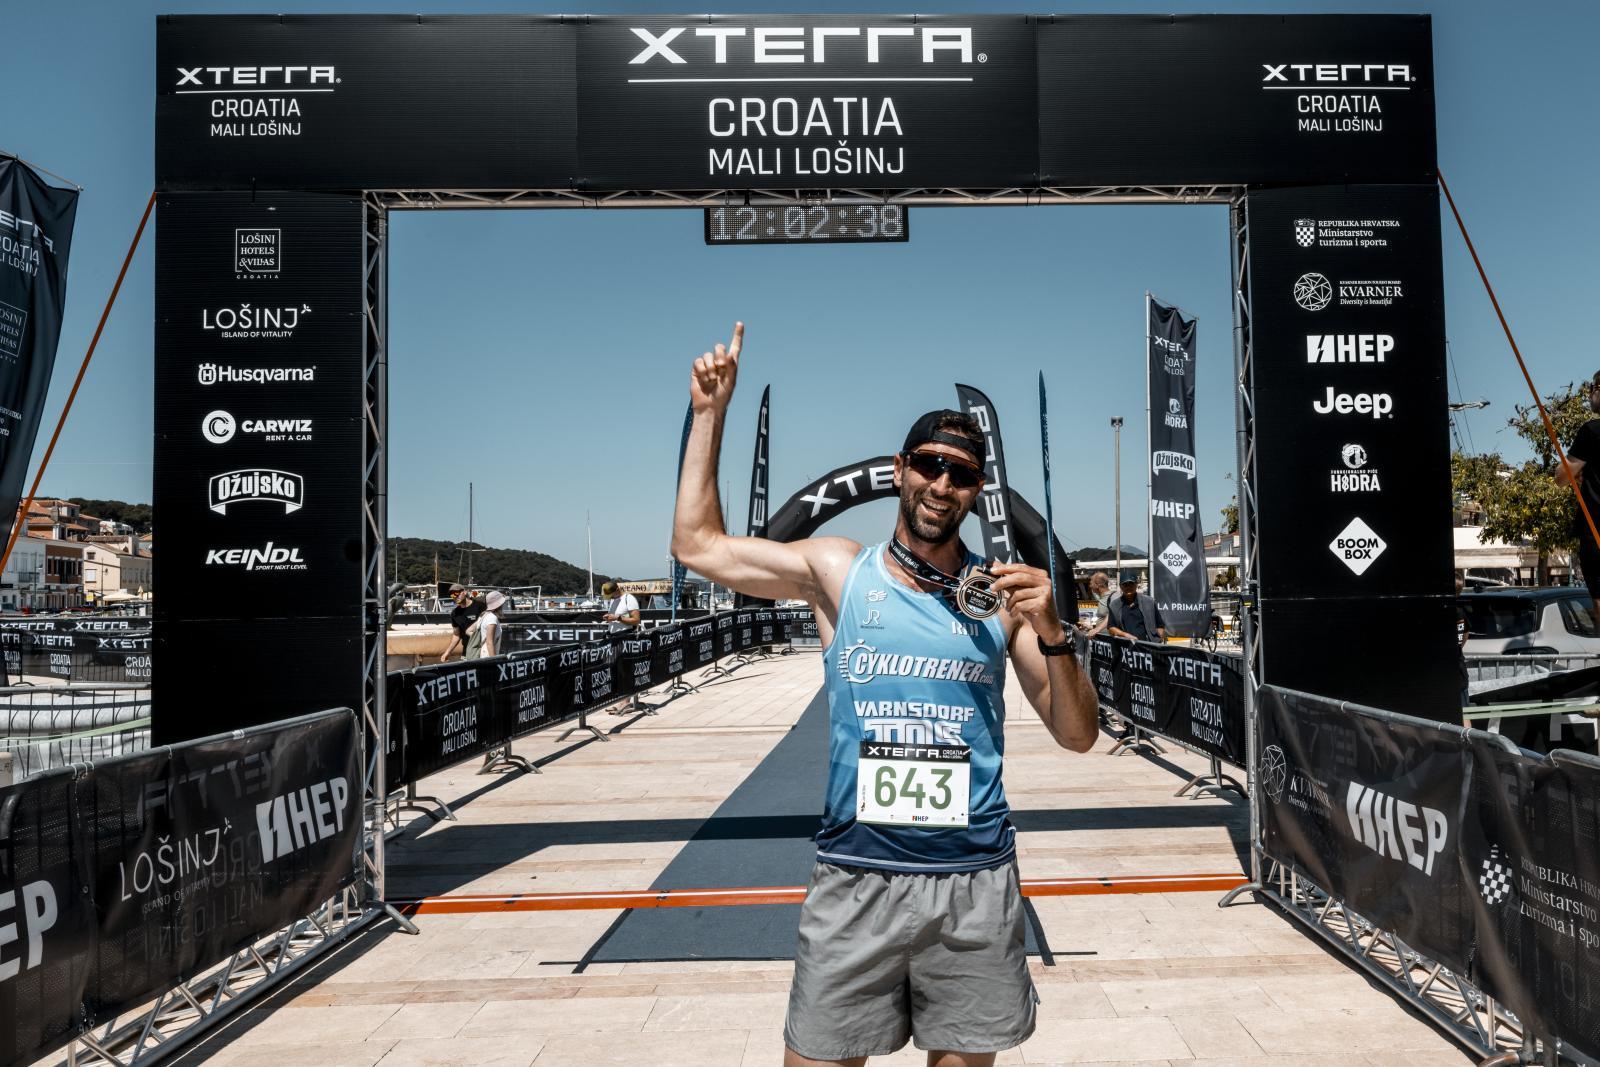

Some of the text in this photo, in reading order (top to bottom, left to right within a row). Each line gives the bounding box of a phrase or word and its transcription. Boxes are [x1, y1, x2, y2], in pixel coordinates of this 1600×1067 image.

[627, 27, 973, 64] XTERRA
[176, 66, 335, 86] XTERRA
[1262, 64, 1410, 82] XTERRA
[211, 98, 301, 118] CROATIA
[1297, 95, 1382, 113] CROATIA
[709, 97, 904, 137] CROATIA
[1298, 116, 1383, 132] MALI LOŠINJ
[210, 119, 301, 137] MALI LOŠINJ
[709, 140, 904, 175] MALI LOŠINJ
[712, 206, 904, 240] 12:02:38
[1319, 228, 1373, 237] Ministarstvo
[241, 233, 275, 244] LOŠINJ
[1319, 237, 1387, 248] turizma i sporta
[0, 237, 40, 266] OATIA
[241, 247, 275, 255] HOTELS
[1339, 286, 1403, 297] KVARNER
[203, 303, 298, 329] LOŠINJ
[1337, 334, 1395, 363] HEP
[218, 365, 315, 384] Husqvarna
[1313, 387, 1393, 419] Jeep
[242, 419, 312, 433] CARWIZ
[1156, 453, 1193, 471] Ožujsko
[218, 472, 296, 500] Ožujsko
[800, 465, 895, 518] XTE
[1163, 502, 1195, 520] HEP
[1337, 538, 1379, 549] BOOM
[205, 542, 304, 570] KEINDL
[1163, 552, 1188, 561] BOOM
[1168, 560, 1184, 568] BOX
[1344, 549, 1372, 560] BOX
[1157, 602, 1169, 611] LA
[98, 638, 152, 649] XTERR
[526, 629, 608, 641] XTERR
[125, 656, 152, 667] CROA
[853, 700, 975, 722] VARNSDORF
[443, 705, 478, 737] CROATIA
[868, 746, 939, 759] XTERRA
[874, 765, 953, 810] 643
[288, 776, 349, 850] HEP
[1374, 793, 1448, 877] HEP
[119, 828, 221, 902] LOŠINJ
[1521, 875, 1598, 922] Ministarstvo
[0, 879, 58, 982] EP
[1579, 927, 1600, 948] spo
